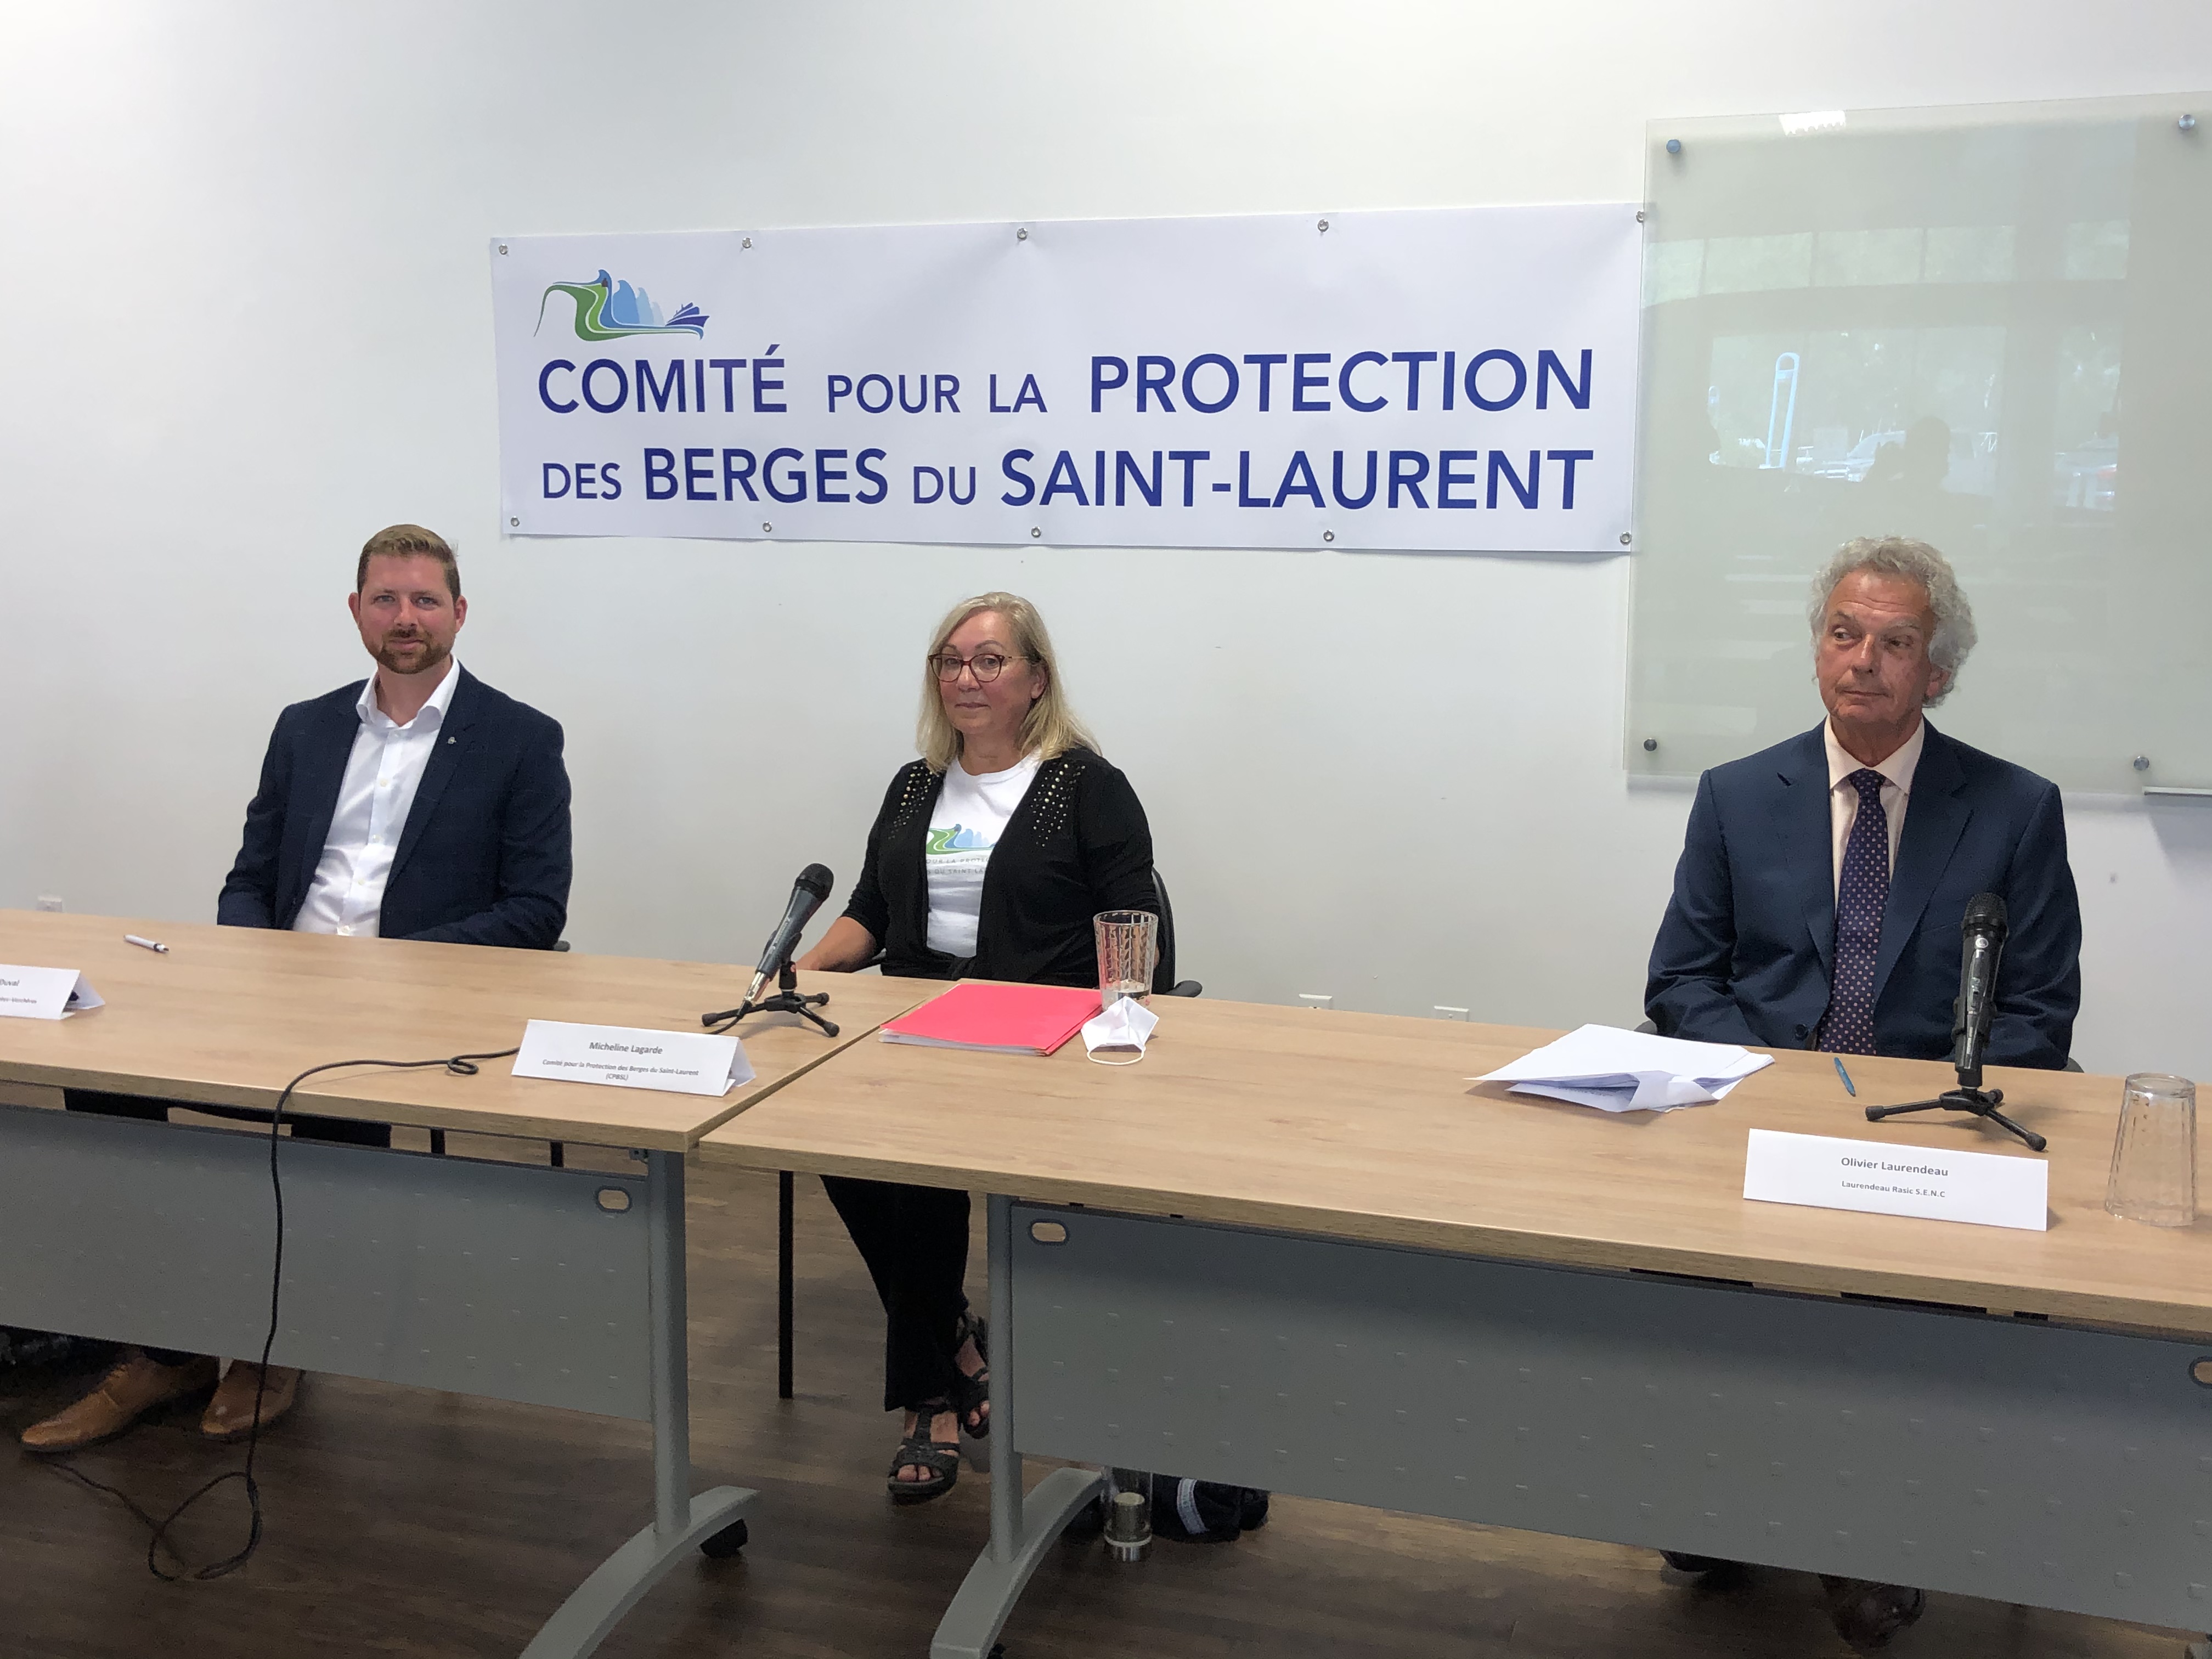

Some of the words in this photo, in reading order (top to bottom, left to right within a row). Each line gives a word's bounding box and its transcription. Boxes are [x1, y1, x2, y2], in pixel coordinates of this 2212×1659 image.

[539, 345, 787, 413] COMITÉ
[828, 374, 960, 413] POUR
[990, 374, 1047, 413] LA
[1092, 349, 1592, 413] PROTECTION
[543, 463, 621, 500] DES
[644, 448, 887, 504] BERGES
[914, 466, 975, 505] DU
[1001, 449, 1593, 509] SAINT-LAURENT
[589, 1042, 629, 1052] Micheline
[631, 1045, 663, 1054] Lagarde
[659, 1068, 699, 1076] Saint-Laurent
[1841, 1158, 1878, 1169] Olivier
[1881, 1161, 1948, 1176] Laurendeau
[1842, 1181, 1890, 1192] Laurendeau
[1892, 1186, 1914, 1194] Rasic
[1915, 1188, 1945, 1198] S.E.N.C
